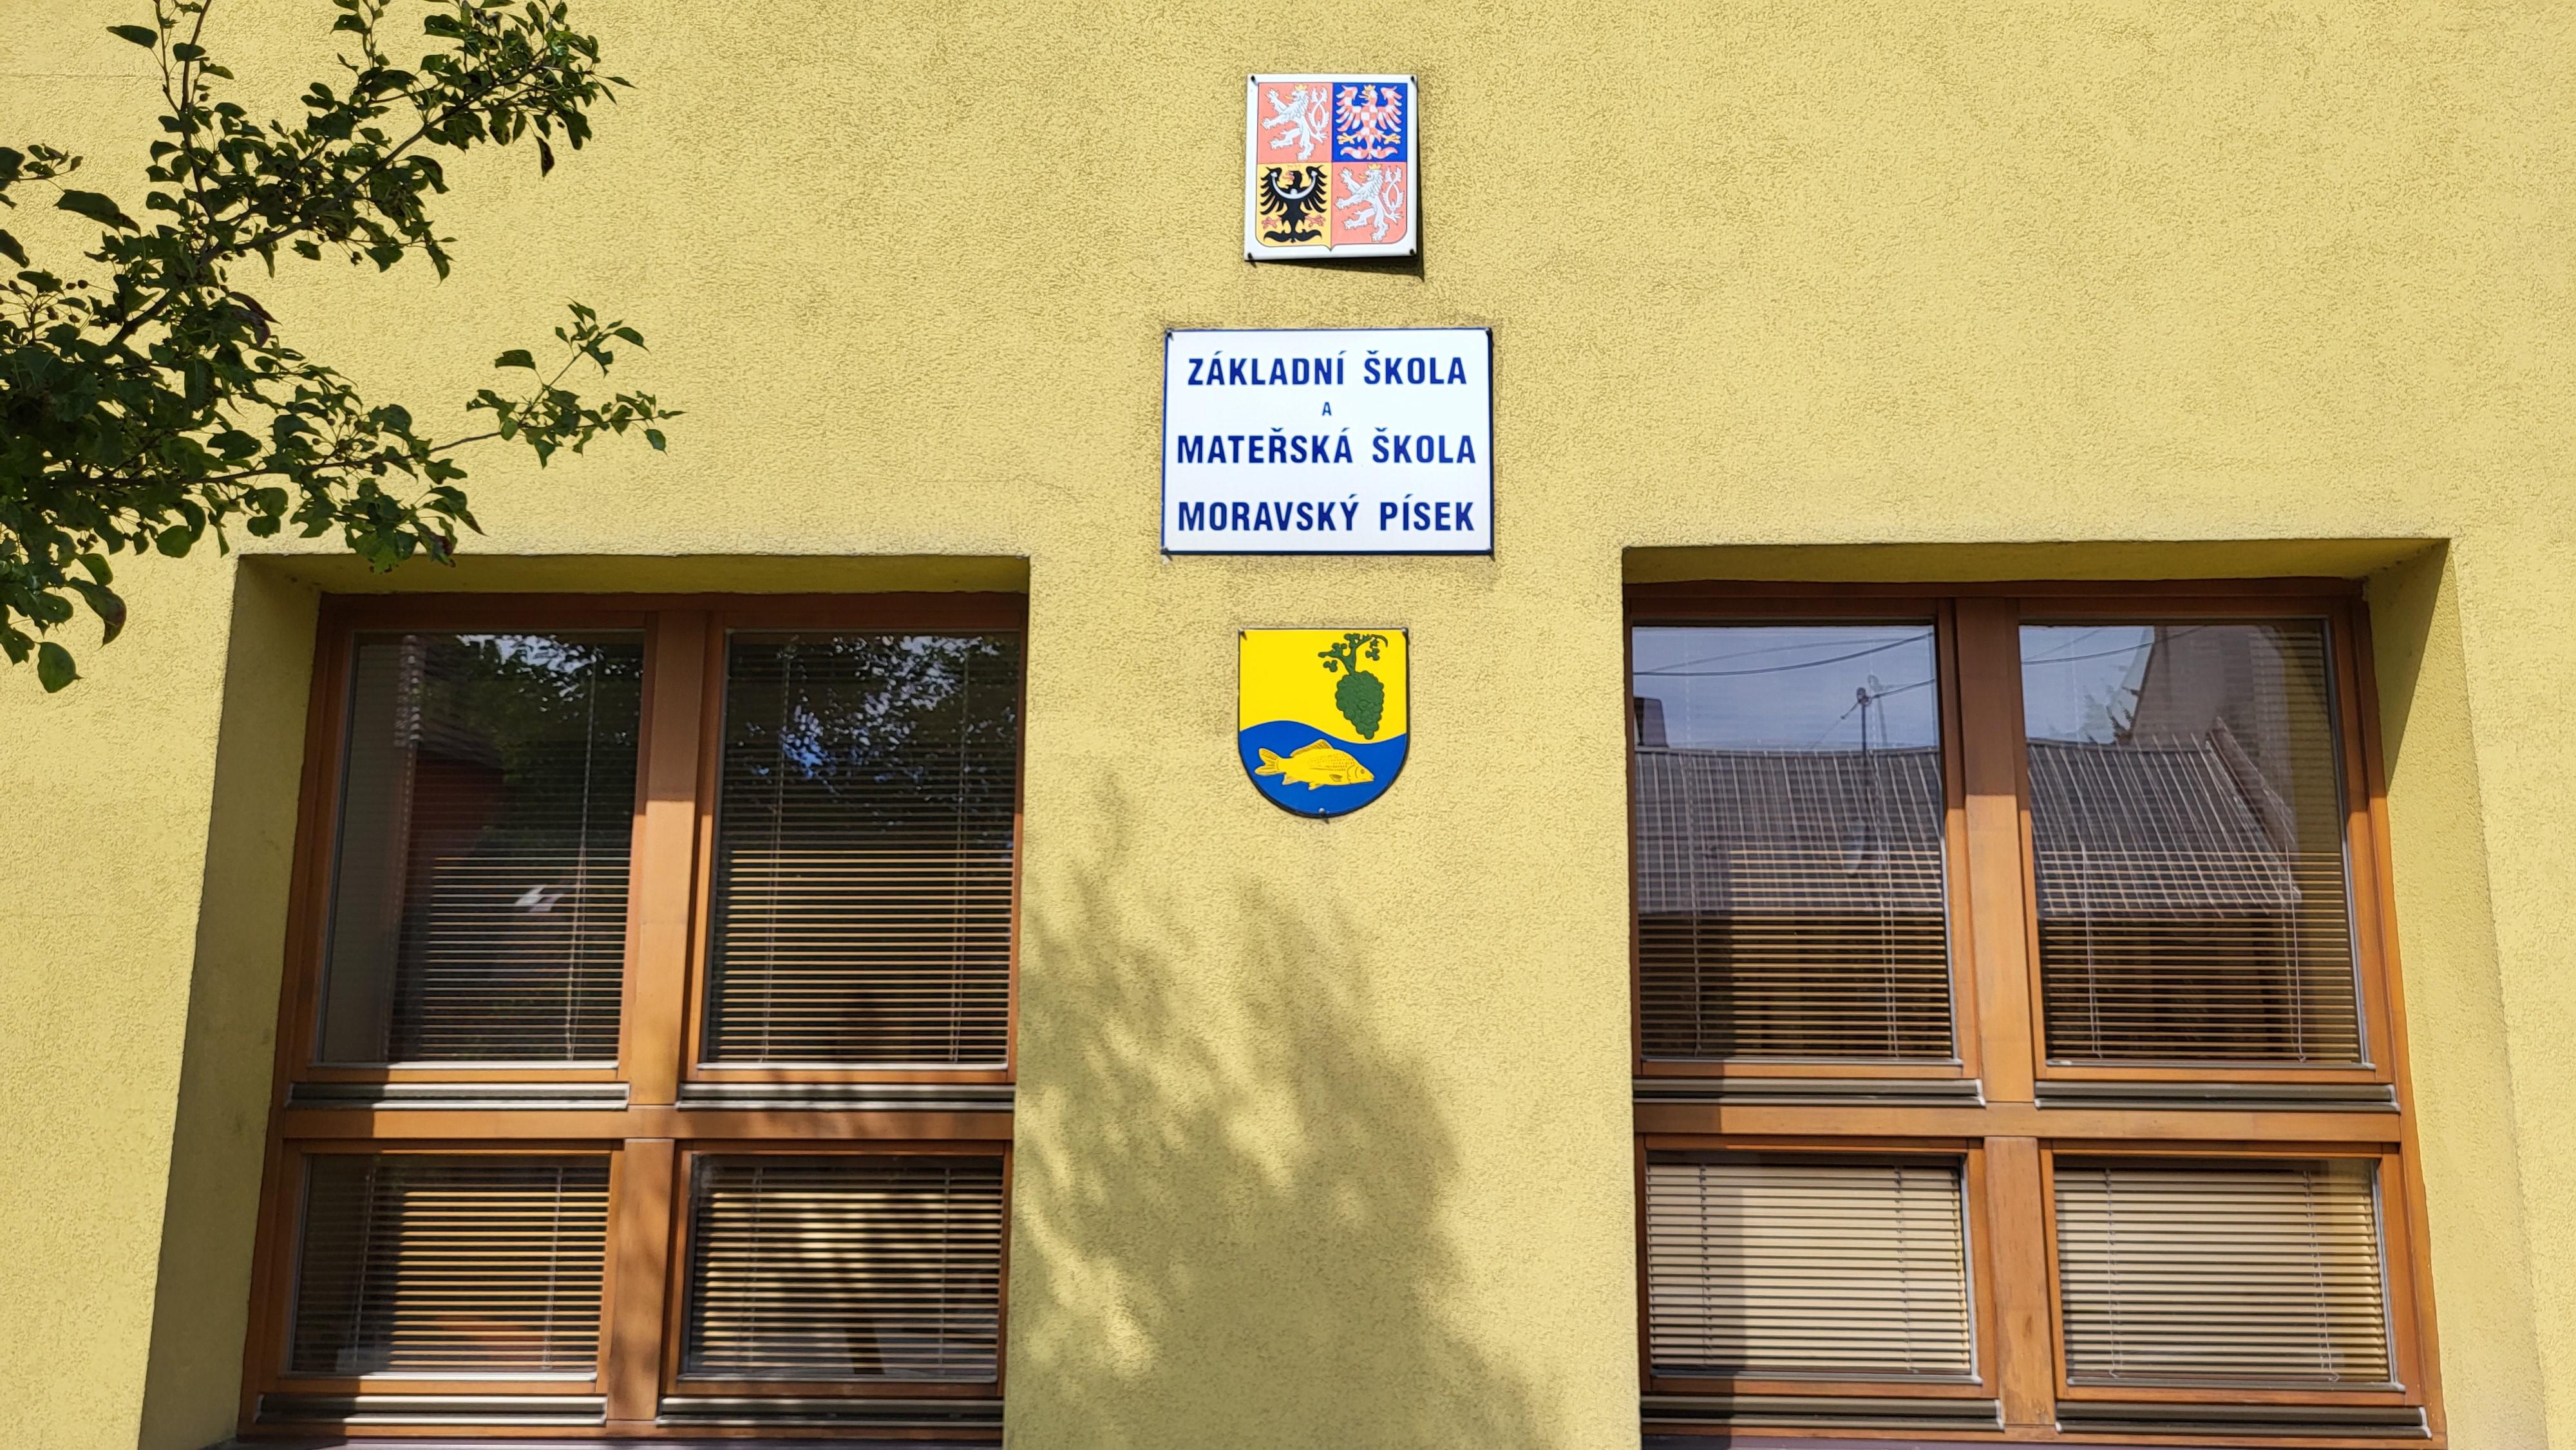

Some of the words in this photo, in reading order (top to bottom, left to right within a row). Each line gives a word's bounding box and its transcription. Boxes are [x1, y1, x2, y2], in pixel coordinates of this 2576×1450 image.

[1188, 350, 1346, 386] ZÁKLADNÍ
[1364, 350, 1466, 385] ŠKOLA
[1321, 402, 1332, 416] A
[1177, 428, 1353, 464] MATEŘSKÁ
[1372, 428, 1476, 464] ŠKOLA
[1179, 494, 1359, 531] MORAVSKÝ
[1380, 494, 1474, 531] PÍSEK
